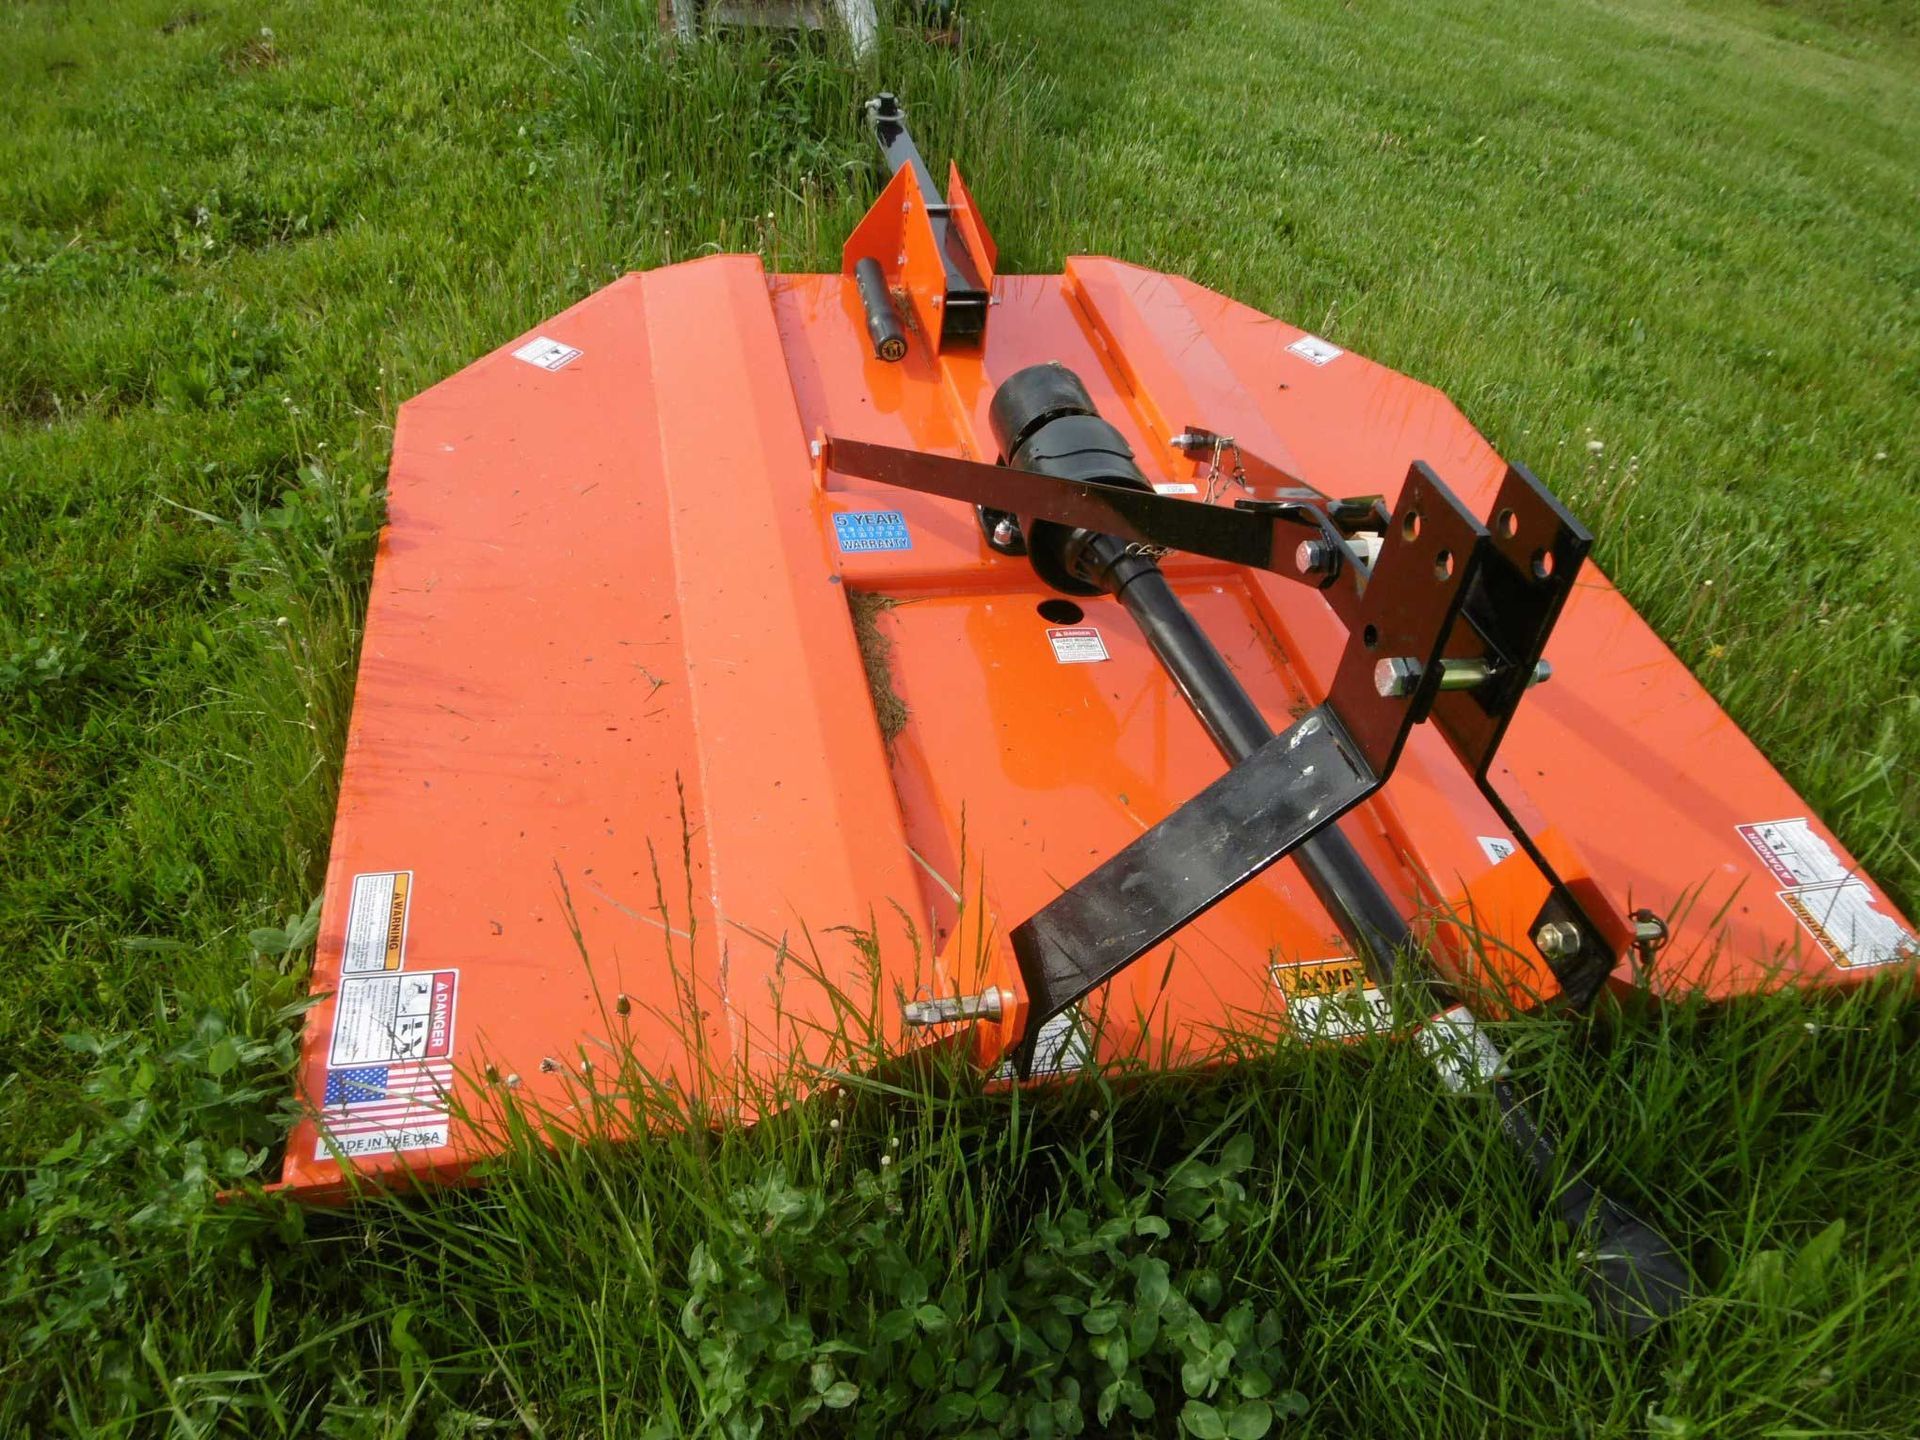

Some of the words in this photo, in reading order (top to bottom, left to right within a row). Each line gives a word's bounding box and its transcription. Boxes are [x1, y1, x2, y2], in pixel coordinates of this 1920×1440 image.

[836, 516, 847, 526] 5
[853, 513, 900, 525] YEAR
[842, 538, 908, 550] WARRANTY
[1747, 832, 1785, 872] DANGER
[388, 900, 403, 951] WARNING
[1788, 897, 1836, 949] WARNING
[432, 993, 448, 1047] DANGER
[368, 1137, 382, 1148] IN
[385, 1134, 409, 1147] THE
[414, 1131, 439, 1142] USA
